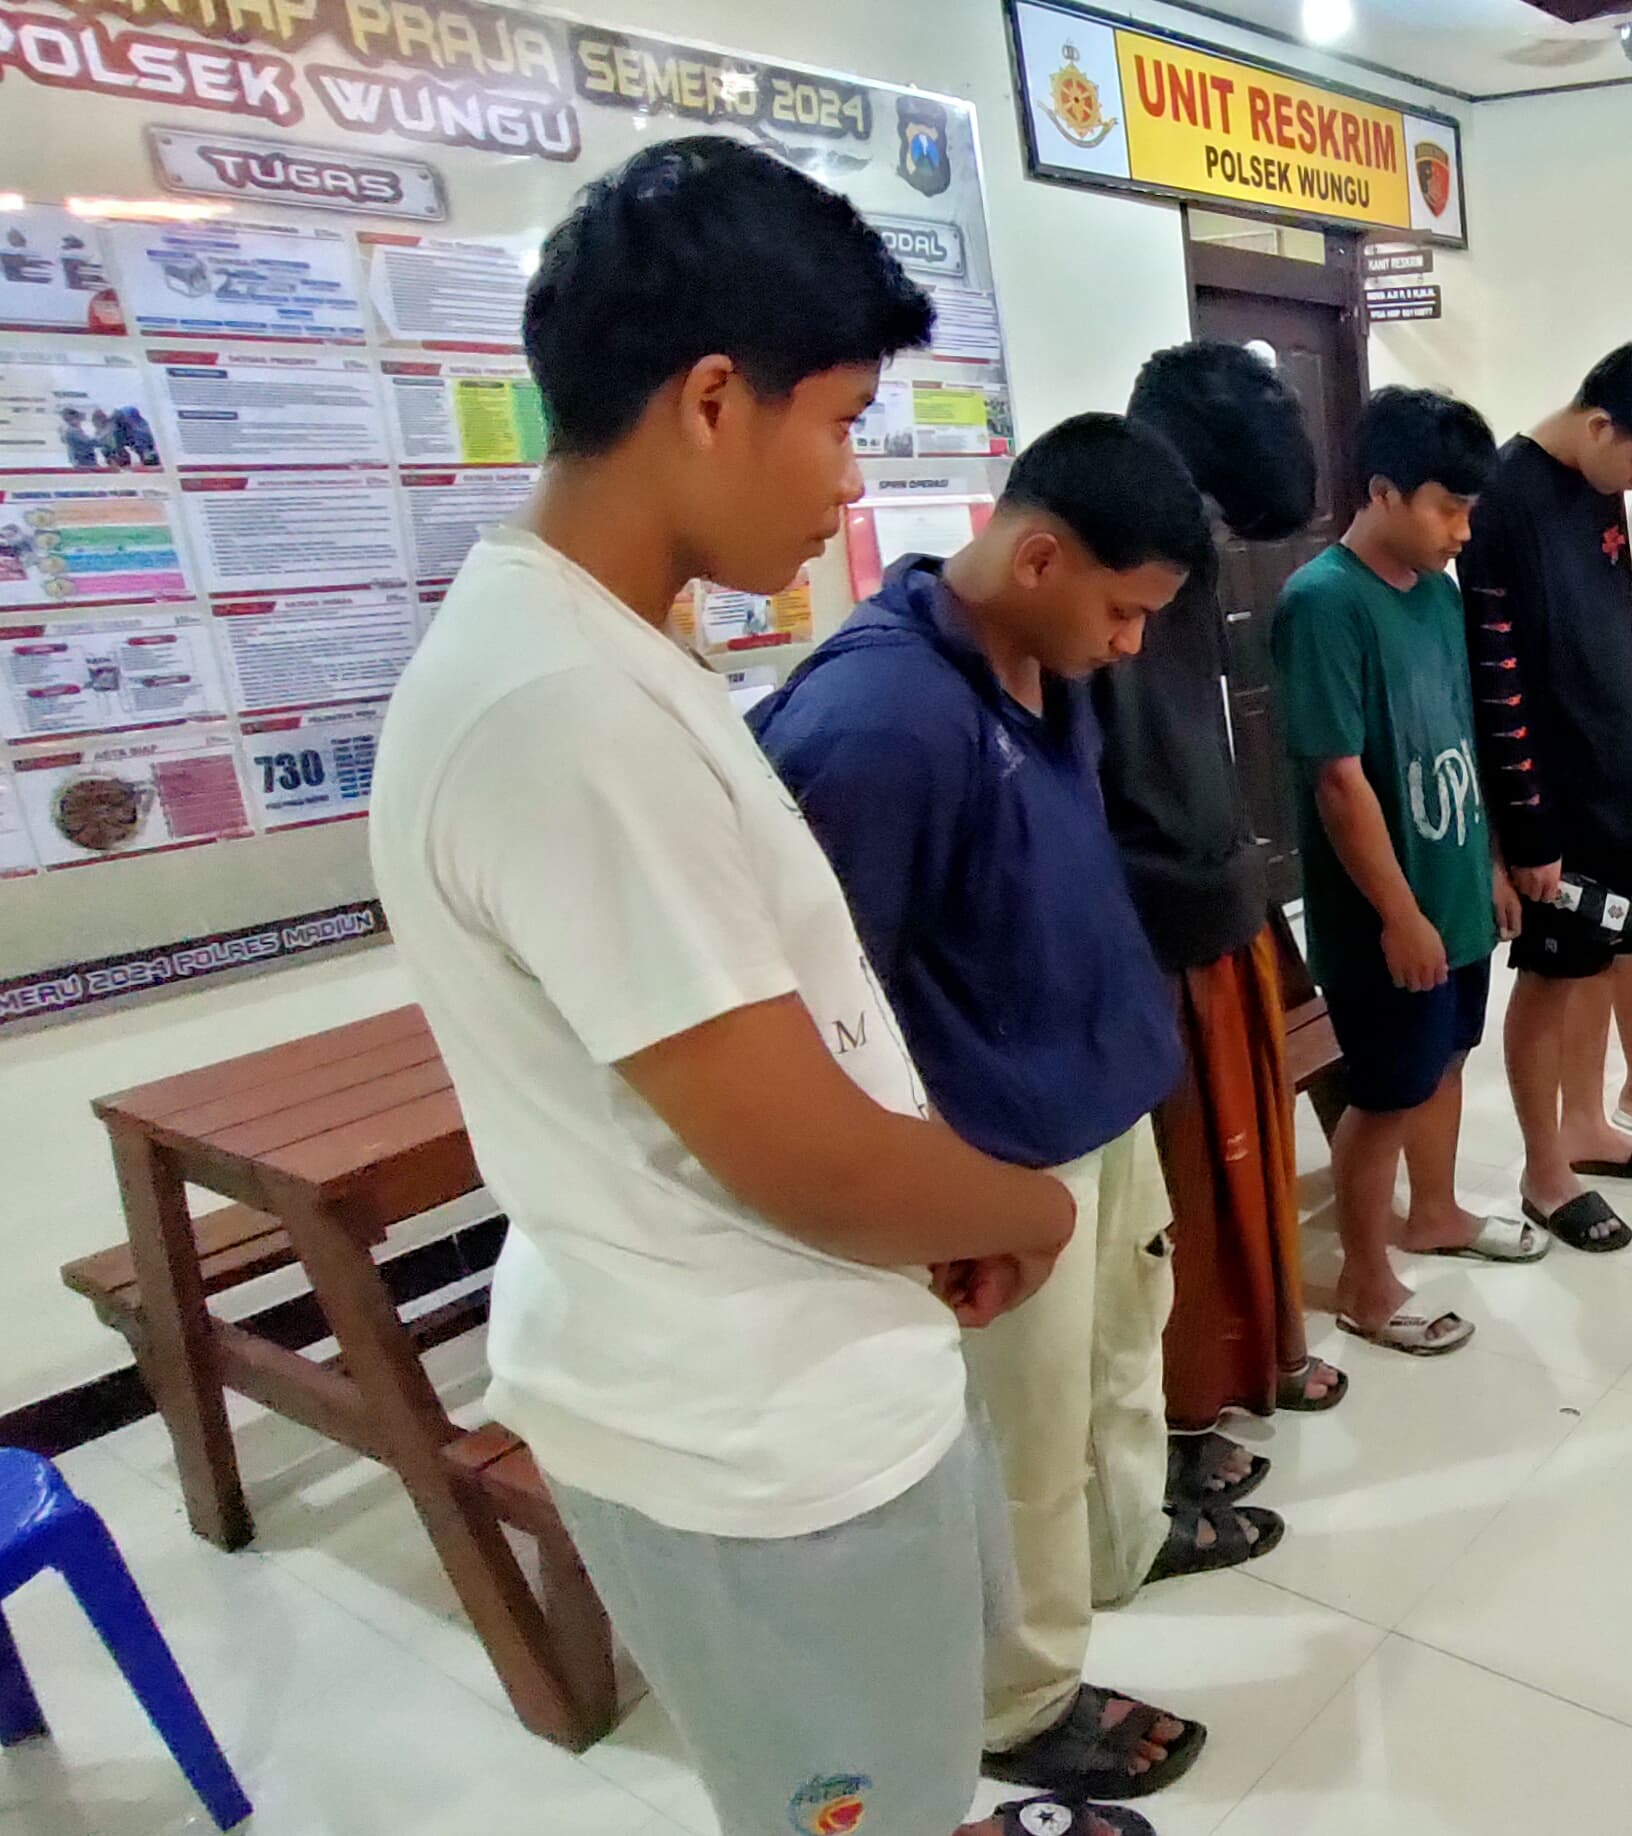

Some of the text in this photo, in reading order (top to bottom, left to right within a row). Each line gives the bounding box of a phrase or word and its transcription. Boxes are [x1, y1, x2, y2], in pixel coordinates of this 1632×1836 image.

[347, 1, 562, 92] PRAJA
[771, 78, 864, 132] 2024
[318, 75, 573, 152] WUNGU
[1134, 54, 1397, 173] UNIT RESKRIM
[211, 154, 394, 197] TUGAS
[1205, 145, 1370, 208] POLSEK WUNGU
[253, 748, 326, 794] 730
[86, 956, 170, 993] 2024
[172, 932, 280, 976] POLRES
[282, 909, 373, 948] MADIUN
